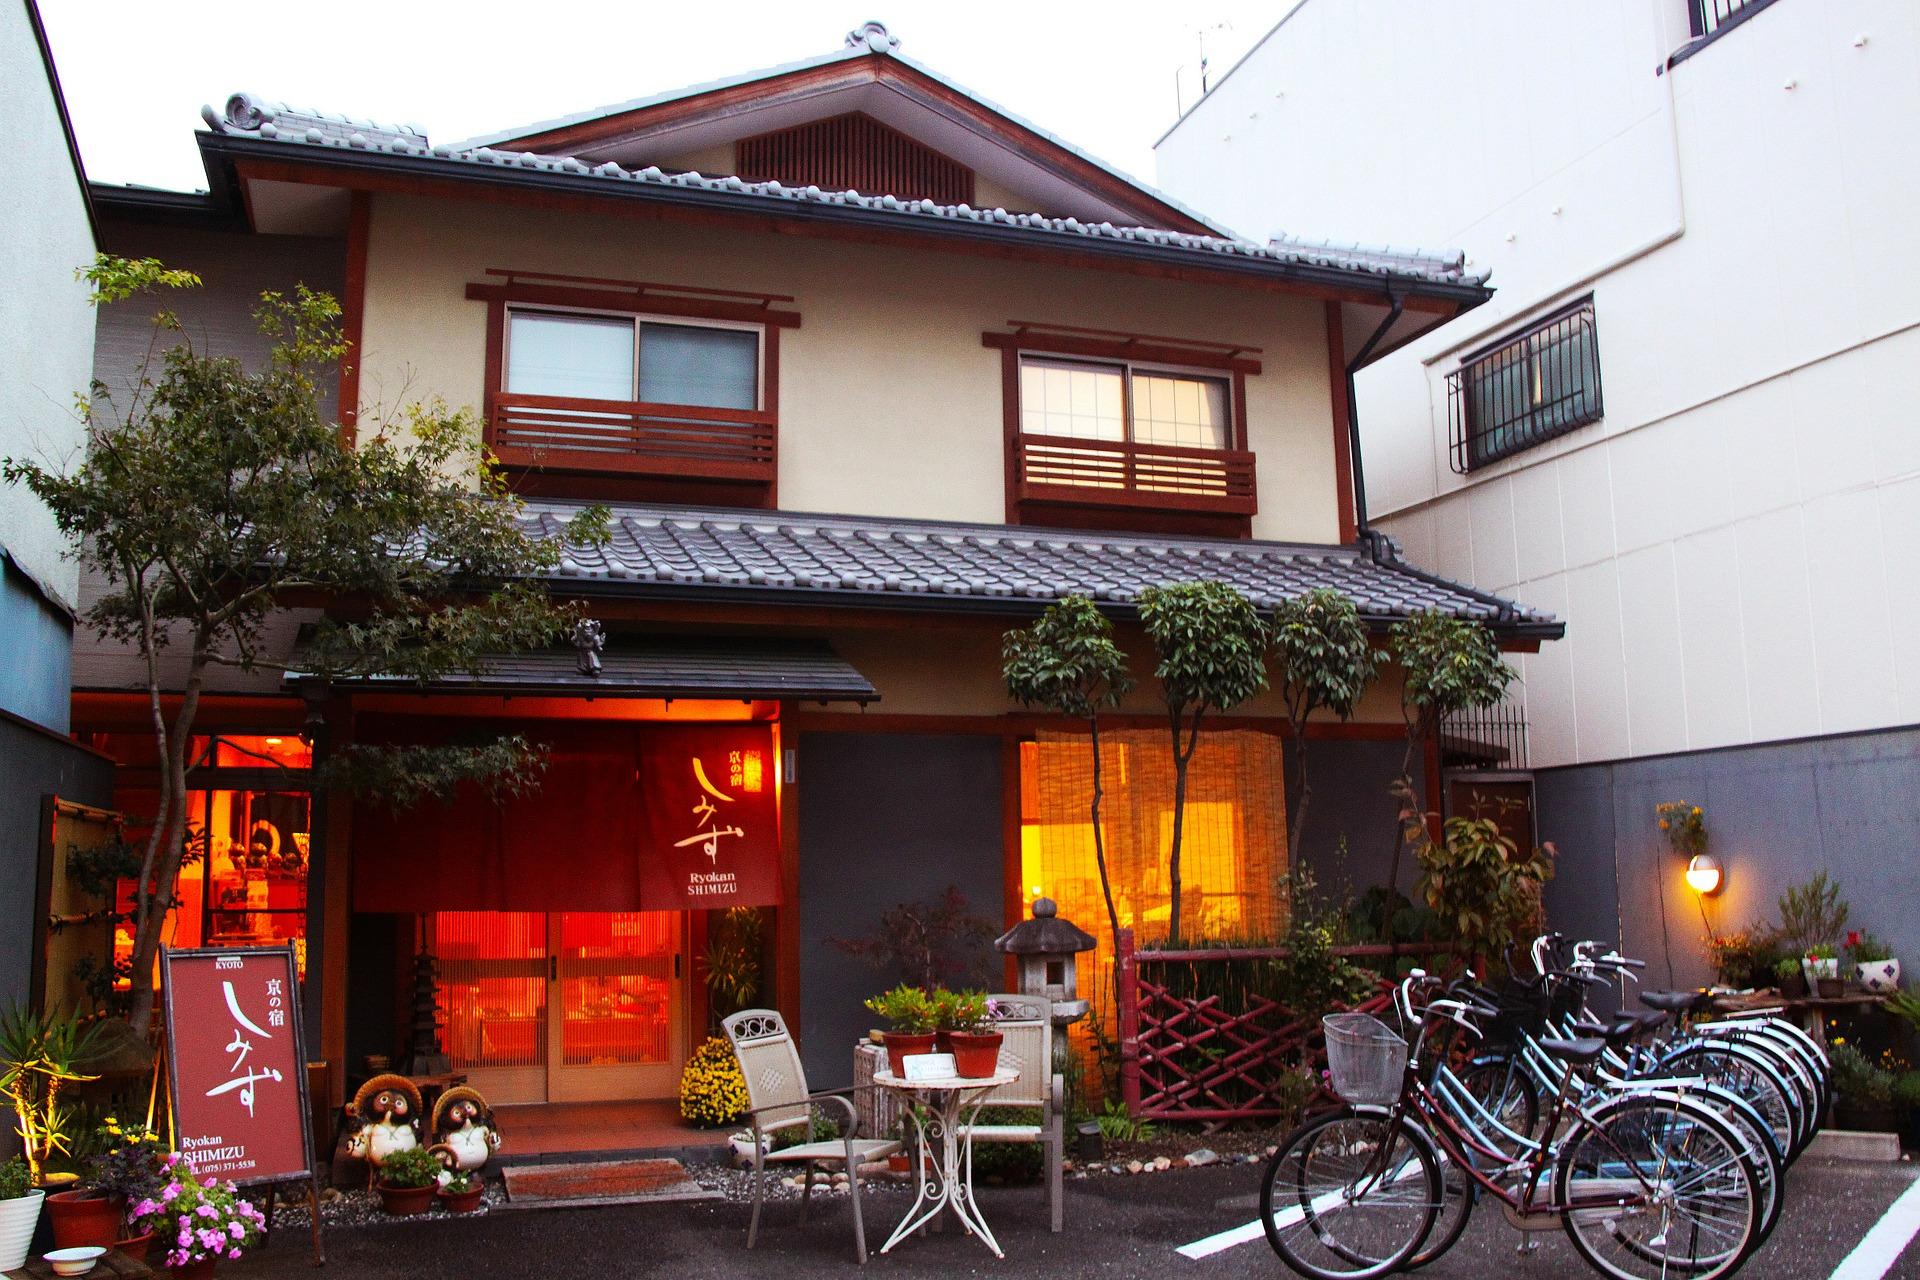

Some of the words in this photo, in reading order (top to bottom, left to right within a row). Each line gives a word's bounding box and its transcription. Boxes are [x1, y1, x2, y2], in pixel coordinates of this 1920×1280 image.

[729, 750, 743, 787] 京の宿
[673, 757, 745, 865] しみず
[689, 871, 736, 885] Ryokan
[687, 882, 738, 896] SHIMIZU
[215, 960, 244, 970] KYOTO
[265, 978, 285, 1027] 京の宿
[205, 980, 283, 1118] しみず
[182, 1134, 223, 1150] Ryokan
[182, 1145, 245, 1166] SHIMIZU
